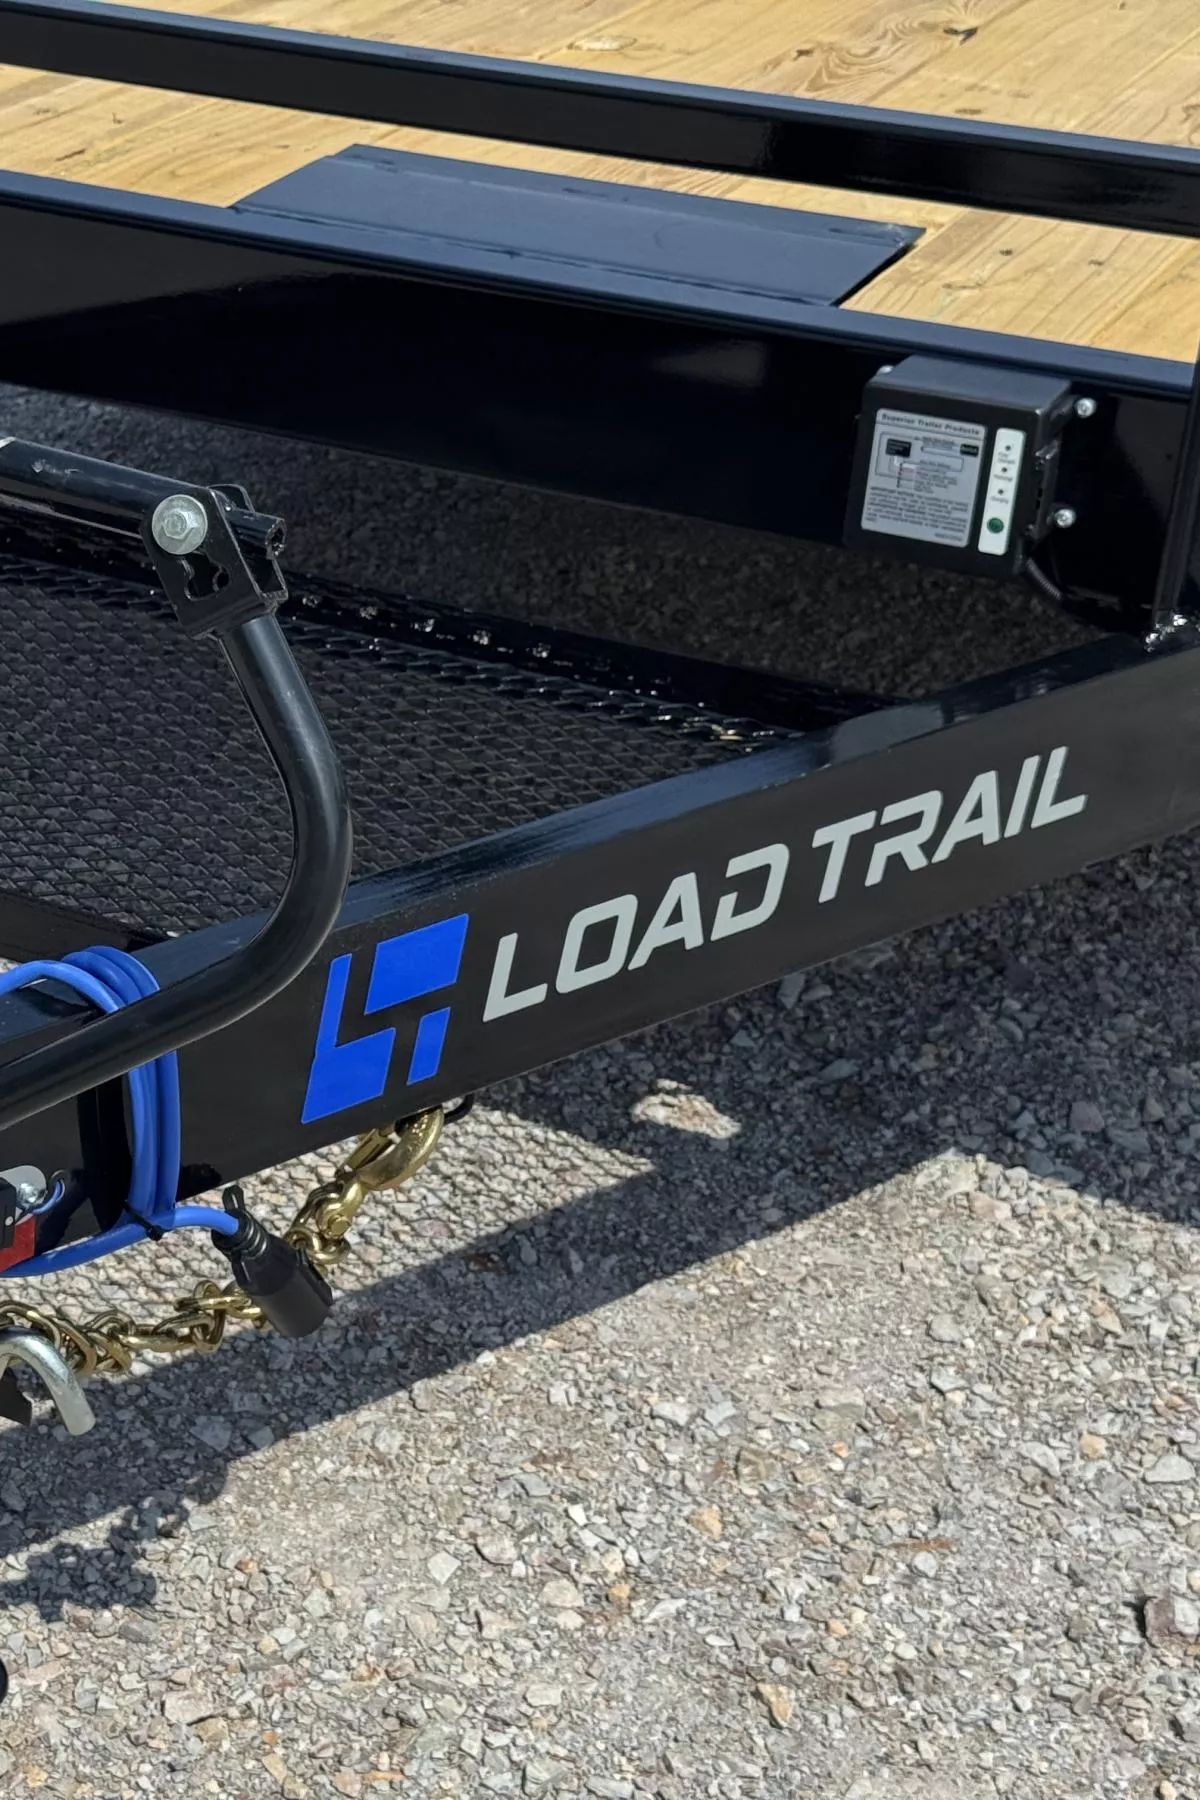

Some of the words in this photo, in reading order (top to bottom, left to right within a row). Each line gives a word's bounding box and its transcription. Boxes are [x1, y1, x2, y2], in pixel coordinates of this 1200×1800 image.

[882, 413, 916, 425] Superior
[918, 418, 942, 429] Trailer
[483, 843, 790, 1022] LOAD
[812, 746, 1088, 903] TRAIL
